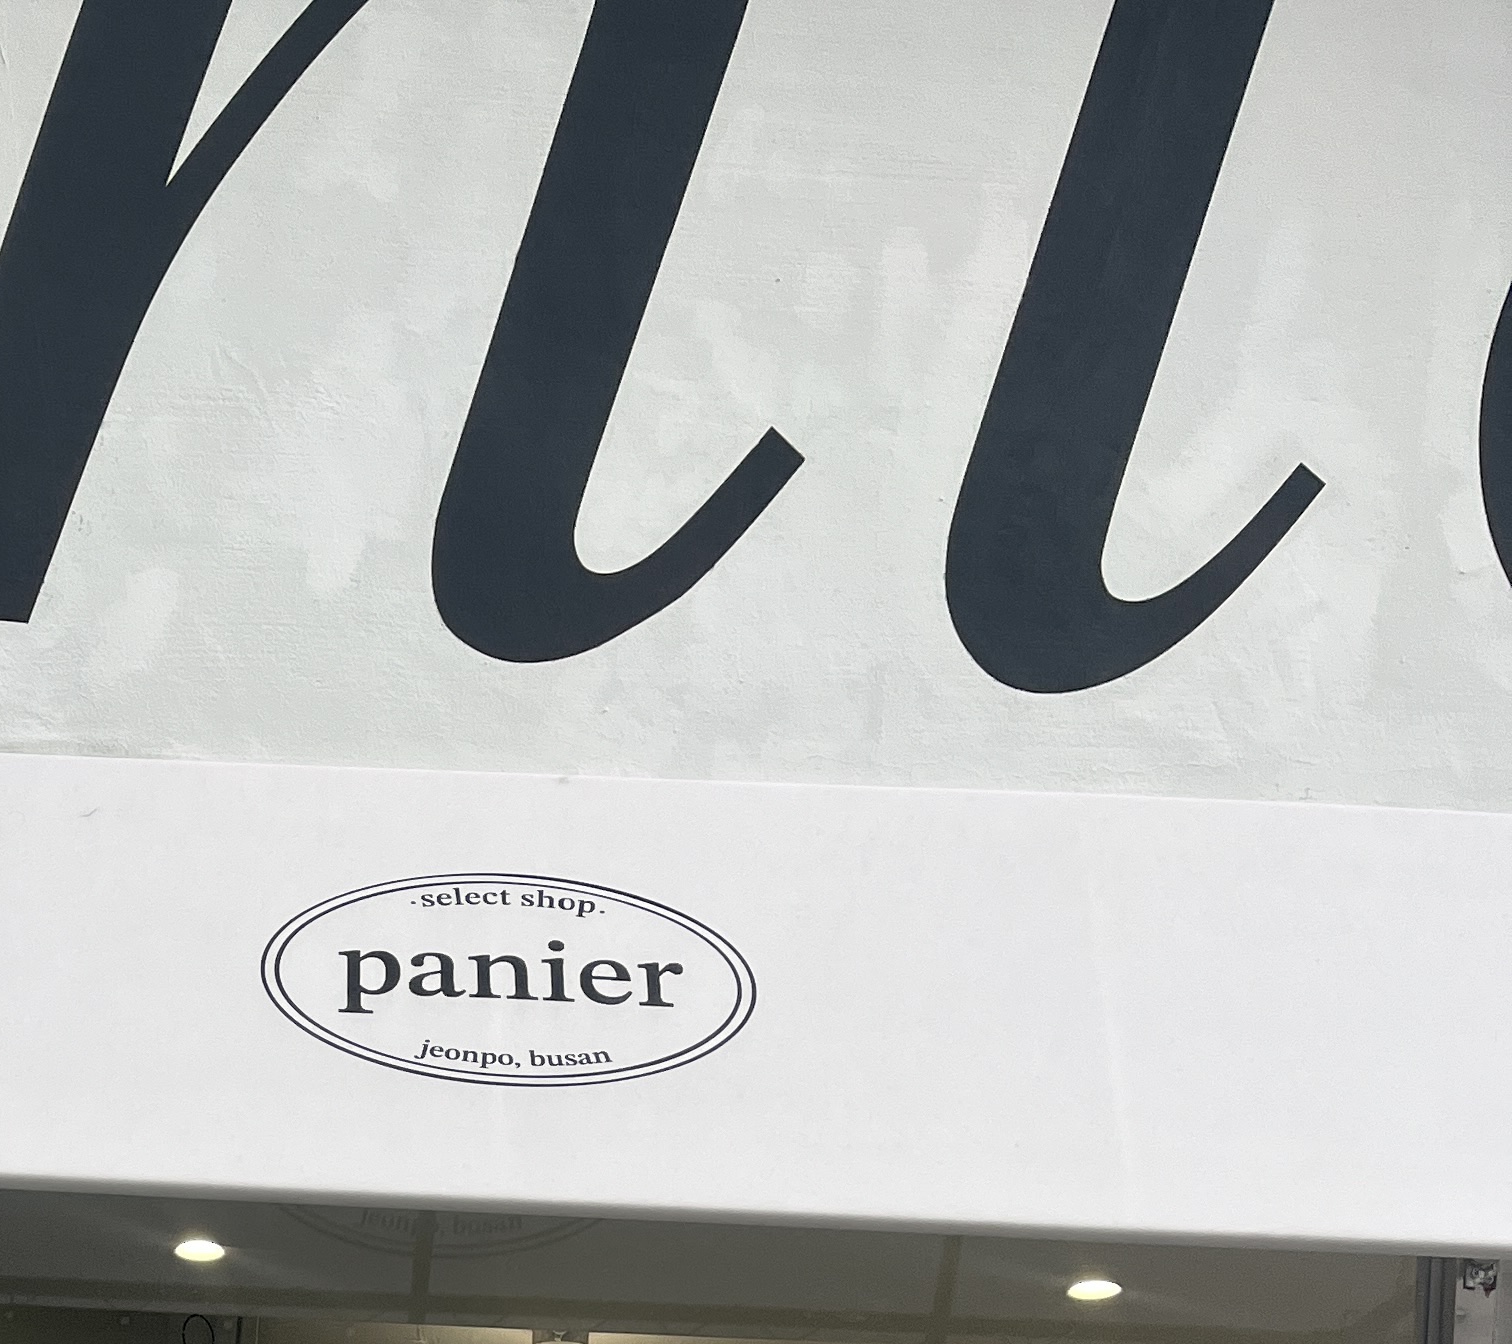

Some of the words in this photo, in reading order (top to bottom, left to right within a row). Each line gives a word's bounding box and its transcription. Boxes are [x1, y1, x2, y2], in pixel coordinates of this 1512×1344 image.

[337, 939, 685, 1015] panier
[413, 1038, 522, 1070] jeonpo,
[528, 1049, 614, 1068] busan
